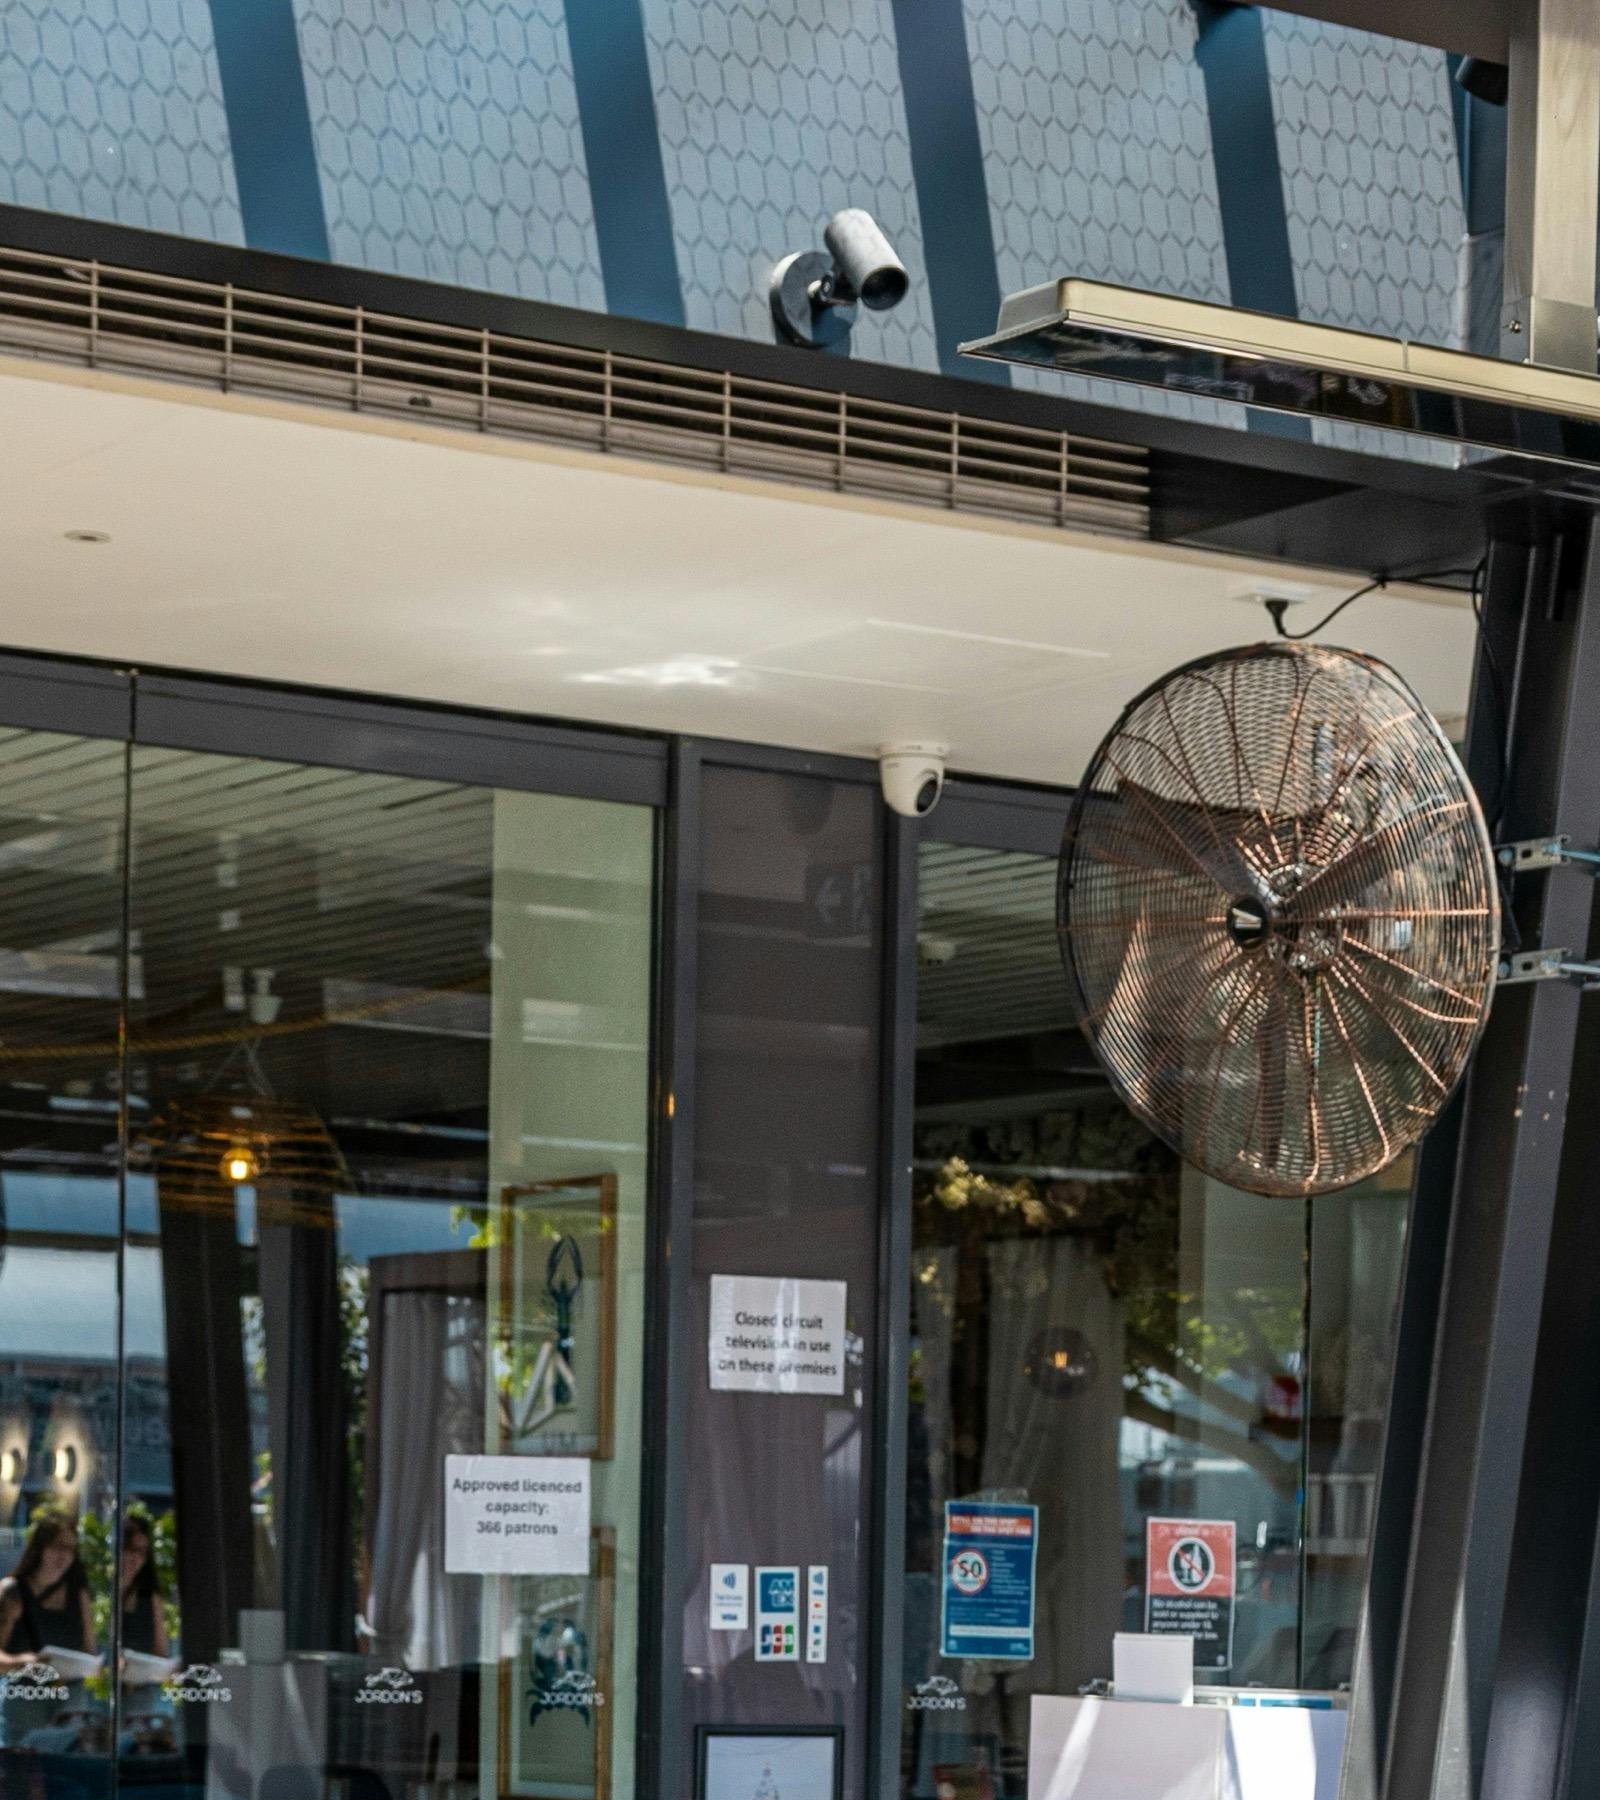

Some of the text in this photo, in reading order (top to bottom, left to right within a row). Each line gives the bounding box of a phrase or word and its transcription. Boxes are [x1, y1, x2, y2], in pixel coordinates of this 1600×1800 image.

[809, 1340, 831, 1352] use
[718, 1359, 735, 1371] on
[738, 1358, 775, 1373] these
[453, 1478, 582, 1496] Approved licenced
[485, 1502, 550, 1516] capacity:
[476, 1521, 558, 1537] 366 patrons
[161, 1686, 232, 1703] JORDON'S
[355, 1689, 423, 1705] JORDON'S
[540, 1692, 605, 1706] JORDON'S
[906, 1696, 967, 1711] JORDON'S
